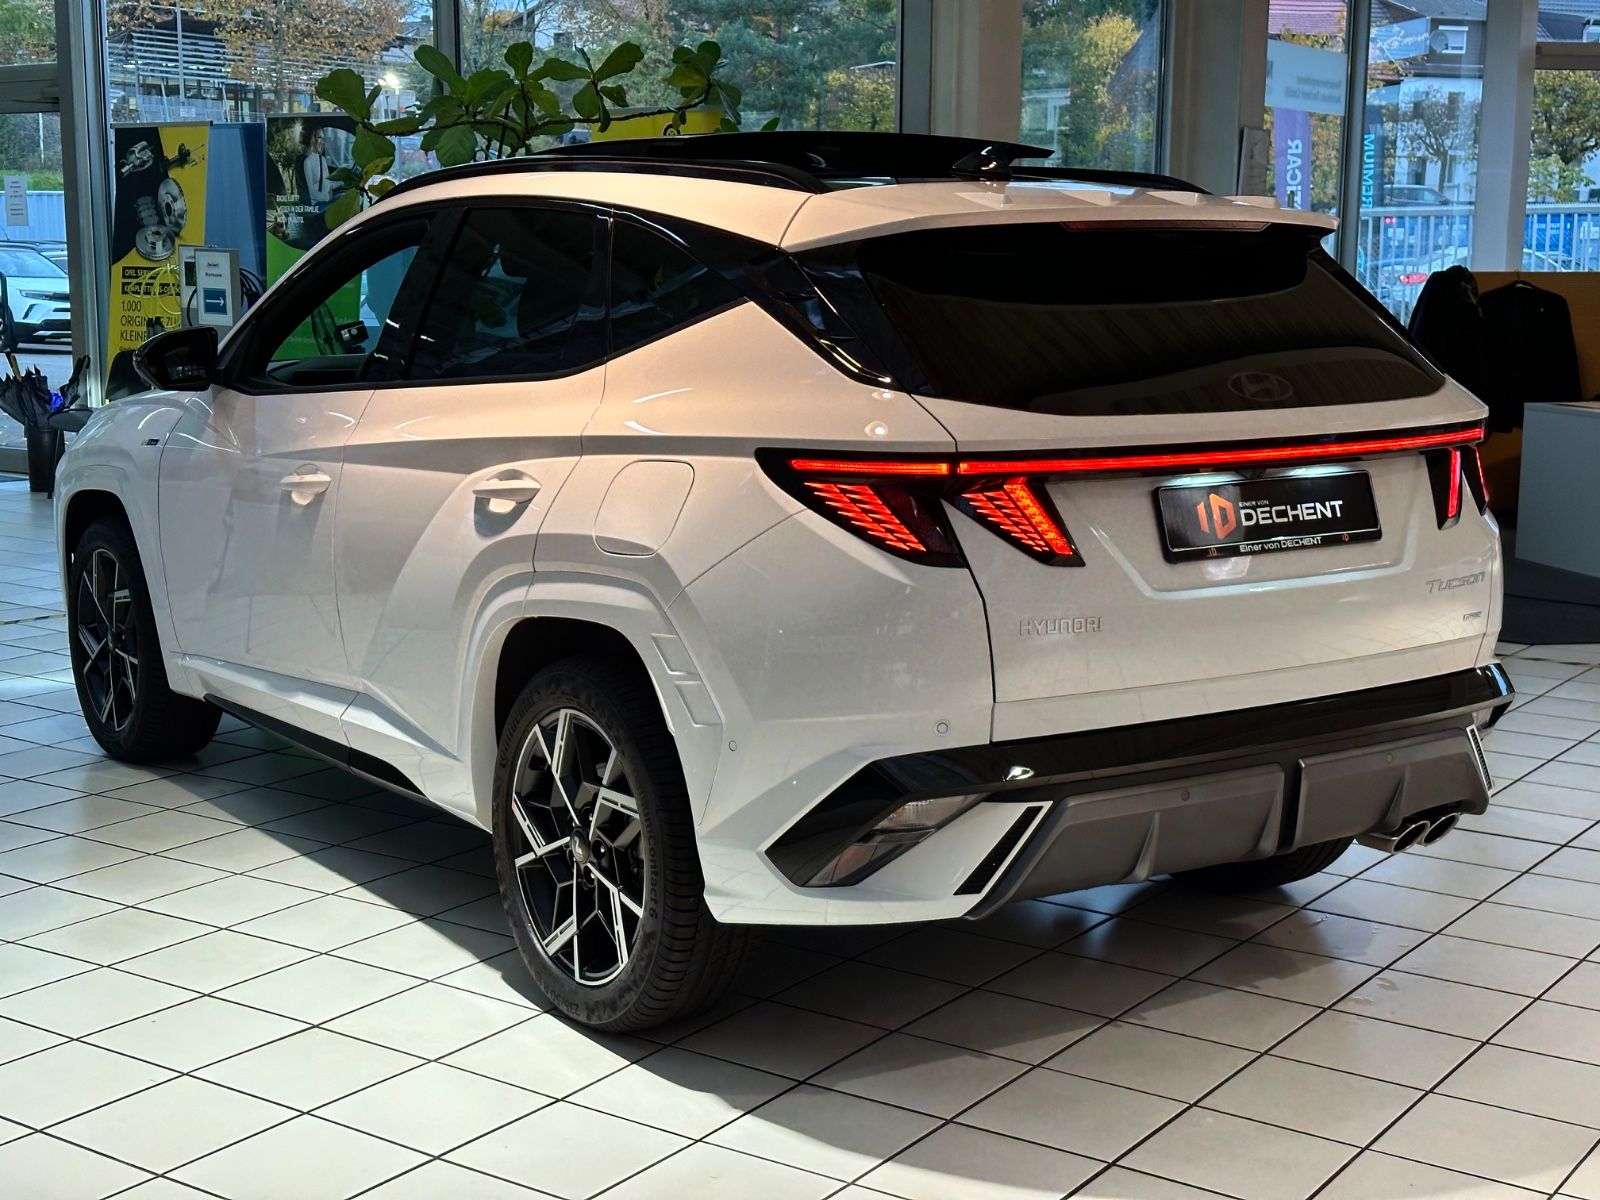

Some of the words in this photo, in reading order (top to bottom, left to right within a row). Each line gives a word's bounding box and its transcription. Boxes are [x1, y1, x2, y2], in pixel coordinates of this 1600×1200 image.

[121, 300, 142, 312] 1.000
[1240, 500, 1343, 526] DECHENT
[1240, 544, 1262, 553] Einer
[1263, 542, 1281, 550] von
[1281, 536, 1322, 548] DECHENT
[1019, 616, 1103, 635] HYUNDAI
